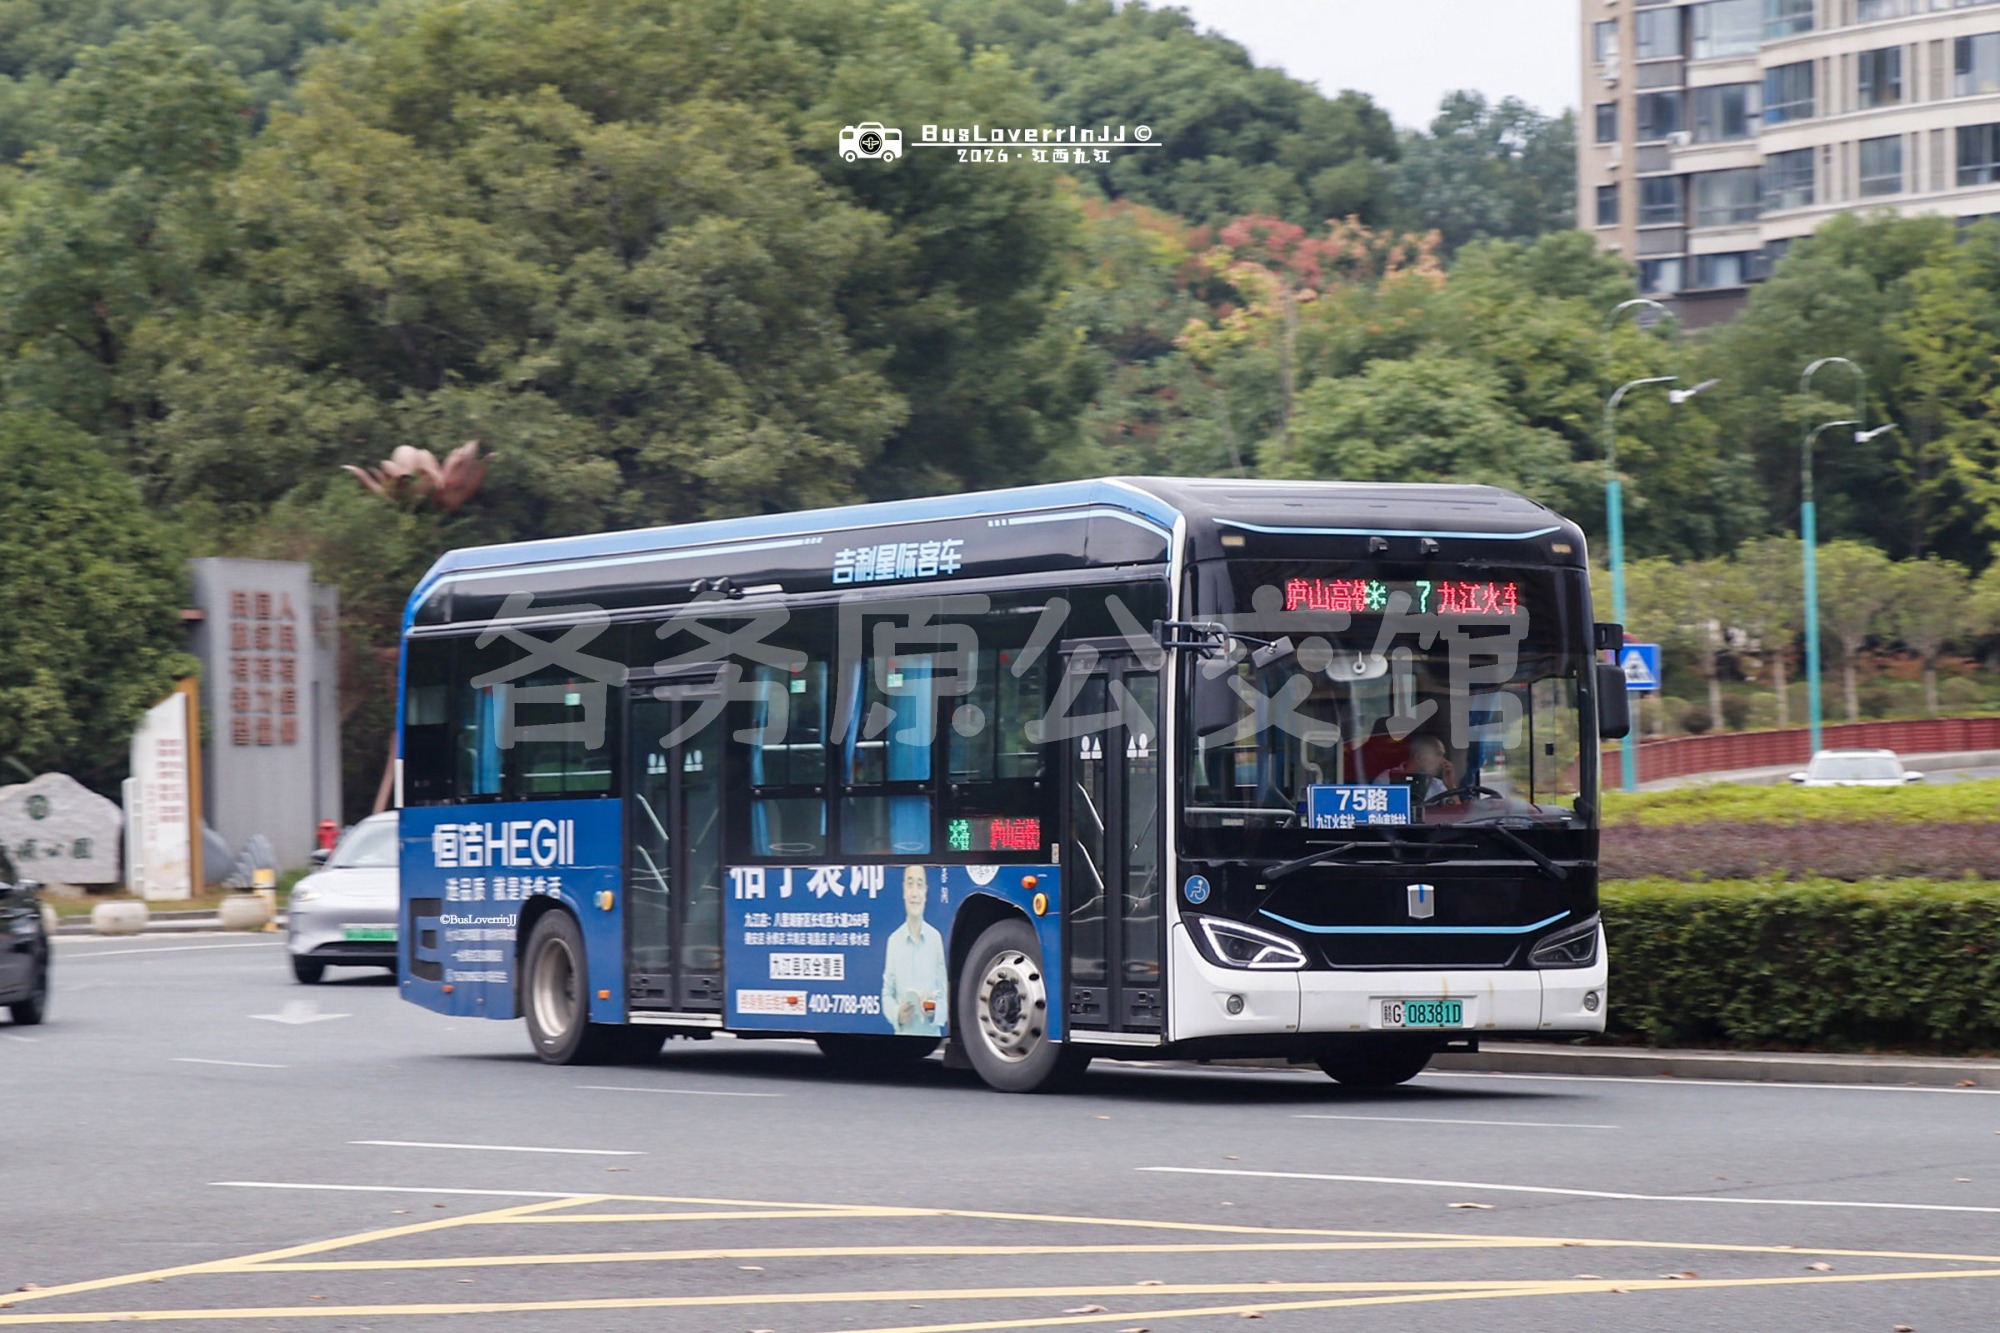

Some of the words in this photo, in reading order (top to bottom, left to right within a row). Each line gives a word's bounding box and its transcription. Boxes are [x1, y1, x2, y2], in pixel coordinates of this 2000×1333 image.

[831, 537, 966, 587] 吉利星际客车
[1437, 581, 1517, 615] 九江火车
[1335, 786, 1389, 812] 75路
[808, 993, 881, 1015] 400-7788-985
